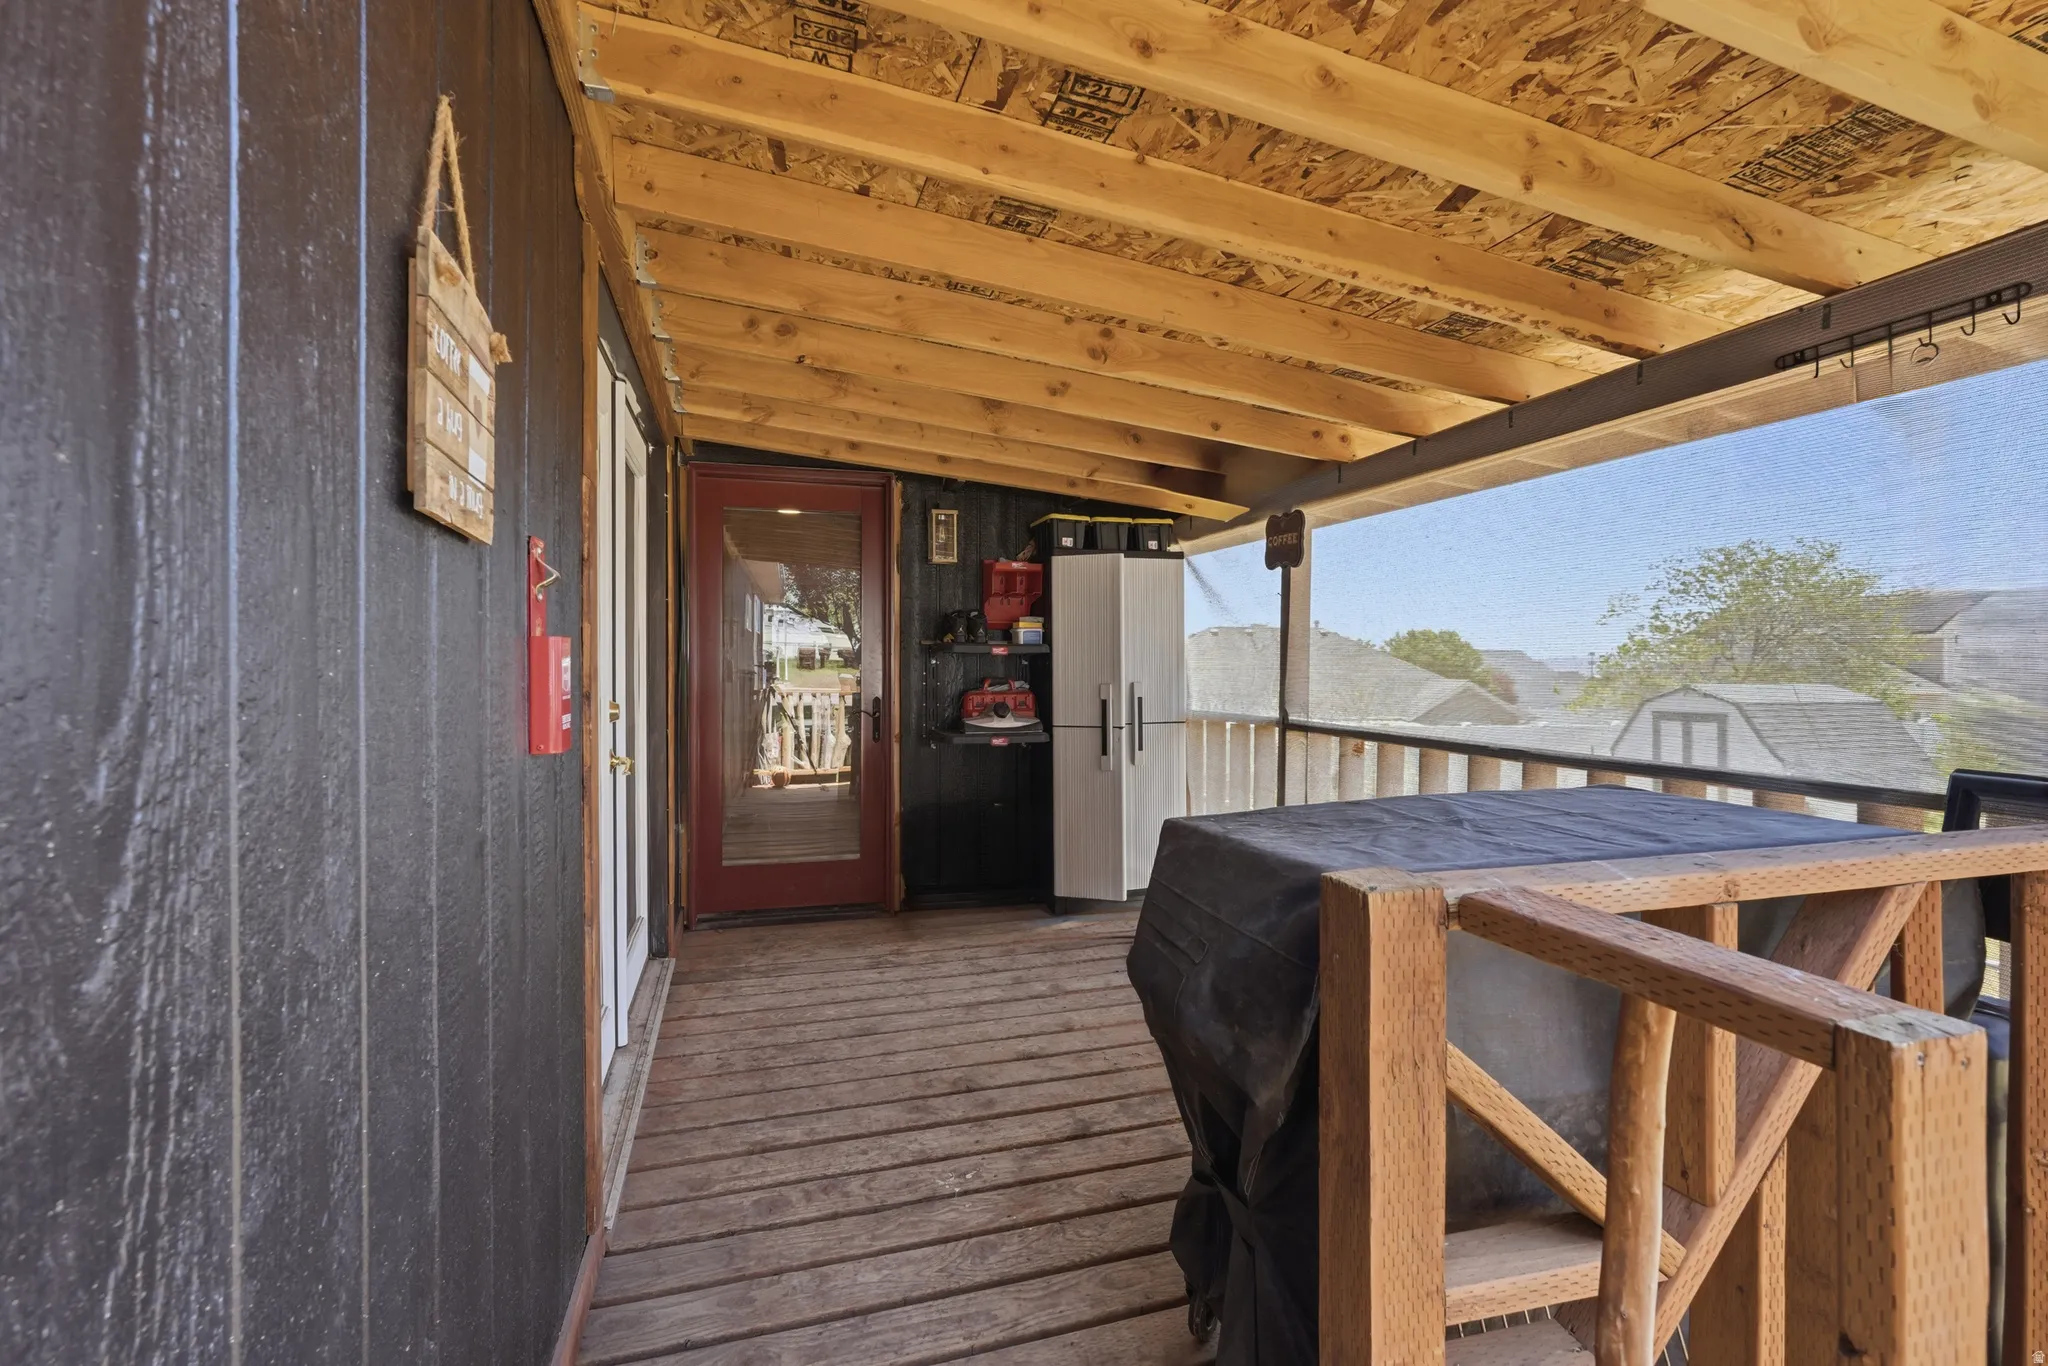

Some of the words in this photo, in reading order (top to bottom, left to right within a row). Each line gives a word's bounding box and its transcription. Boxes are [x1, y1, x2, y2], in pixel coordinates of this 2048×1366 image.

[800, 22, 852, 45] 2023
[1059, 105, 1109, 126] APA
[1267, 532, 1299, 548] COFFEE
